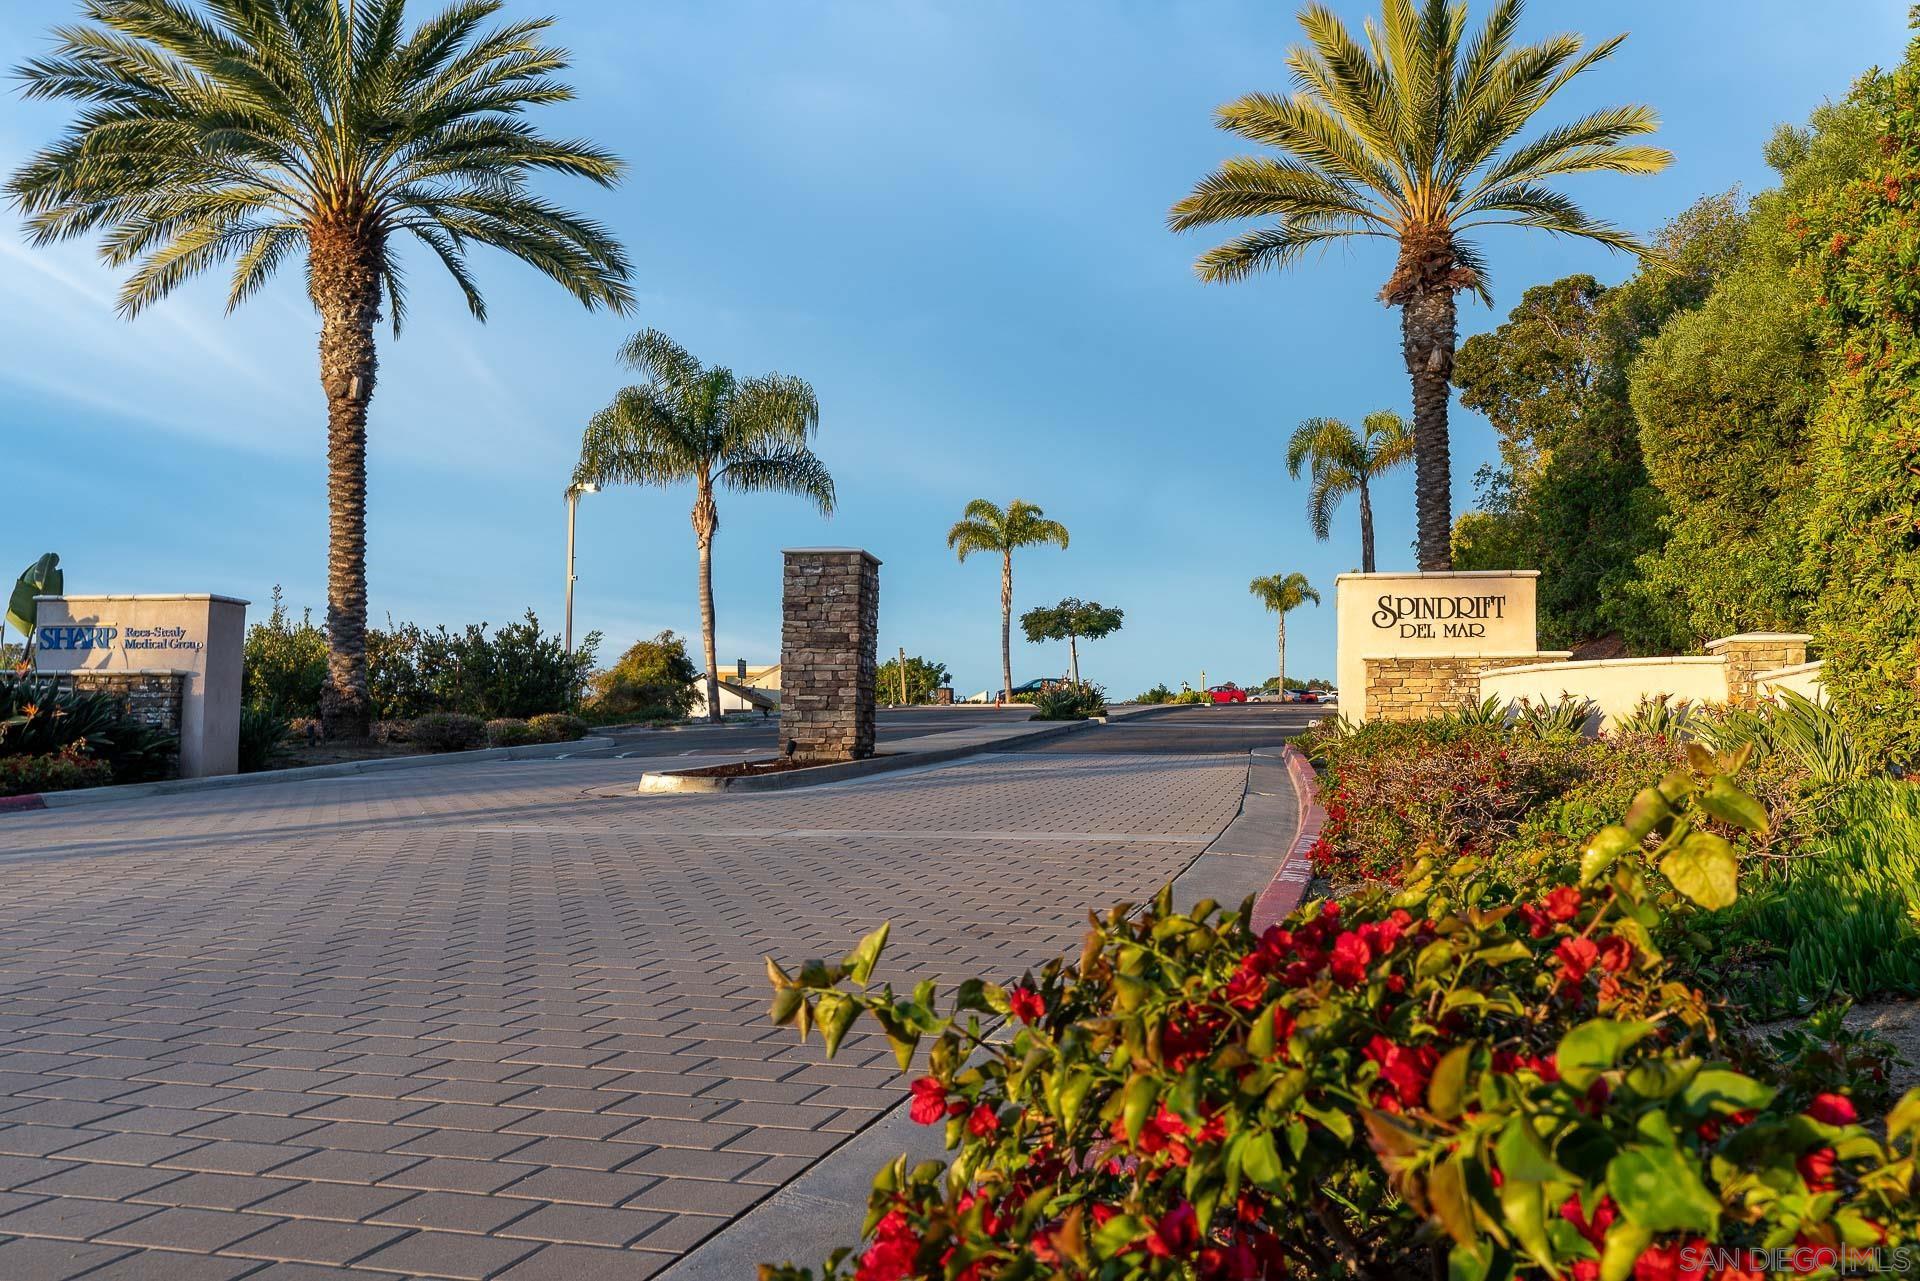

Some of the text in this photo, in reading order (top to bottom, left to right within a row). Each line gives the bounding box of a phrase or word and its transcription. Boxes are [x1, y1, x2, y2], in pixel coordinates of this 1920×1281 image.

[1371, 594, 1506, 629] SPINDRIFT
[39, 627, 118, 650] SHARP
[124, 627, 187, 641] Rees-Stealy
[1400, 623, 1486, 639] DEL MAR
[124, 638, 204, 653] Medical Group
